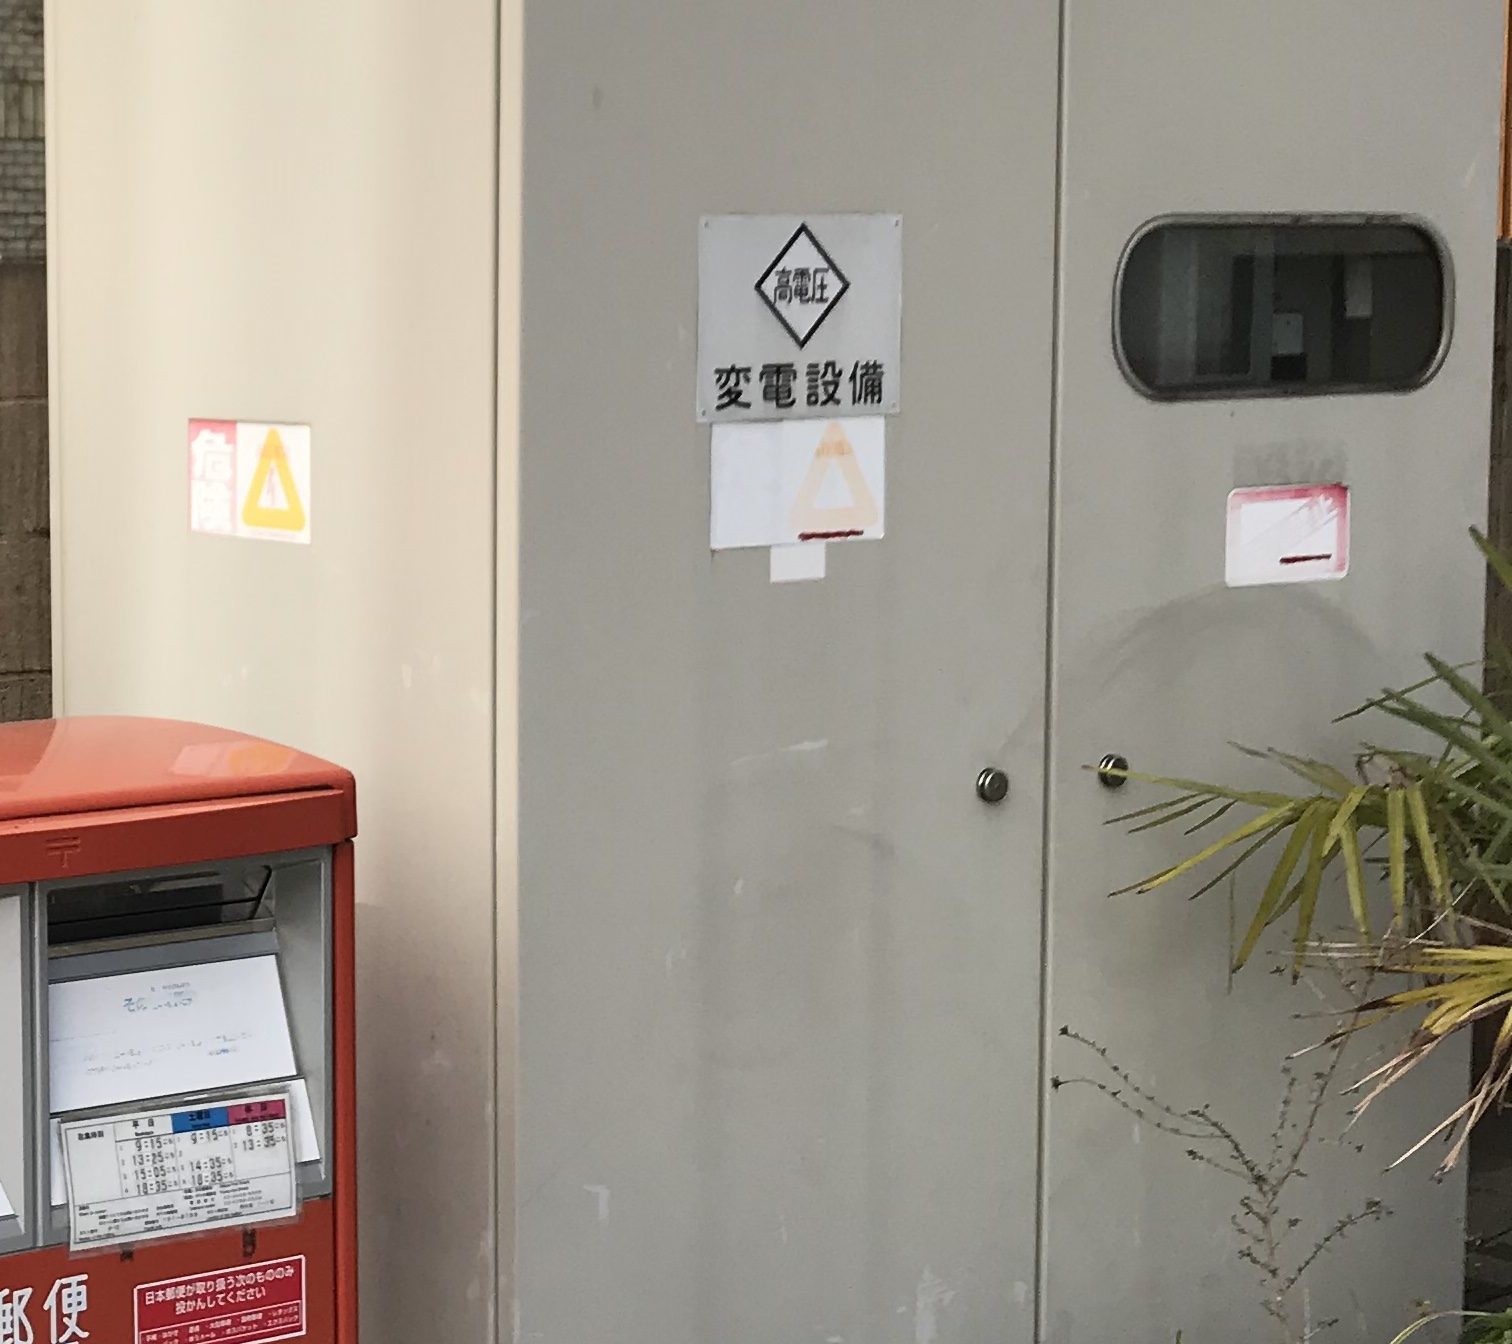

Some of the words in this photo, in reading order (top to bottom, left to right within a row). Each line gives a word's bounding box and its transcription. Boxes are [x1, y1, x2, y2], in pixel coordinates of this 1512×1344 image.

[774, 267, 830, 306] 高電圧
[714, 359, 885, 413] 変電設備
[145, 1264, 295, 1306] 日本郵便が取り扱う次のもののみ
[175, 1286, 267, 1316] 投かんしてください
